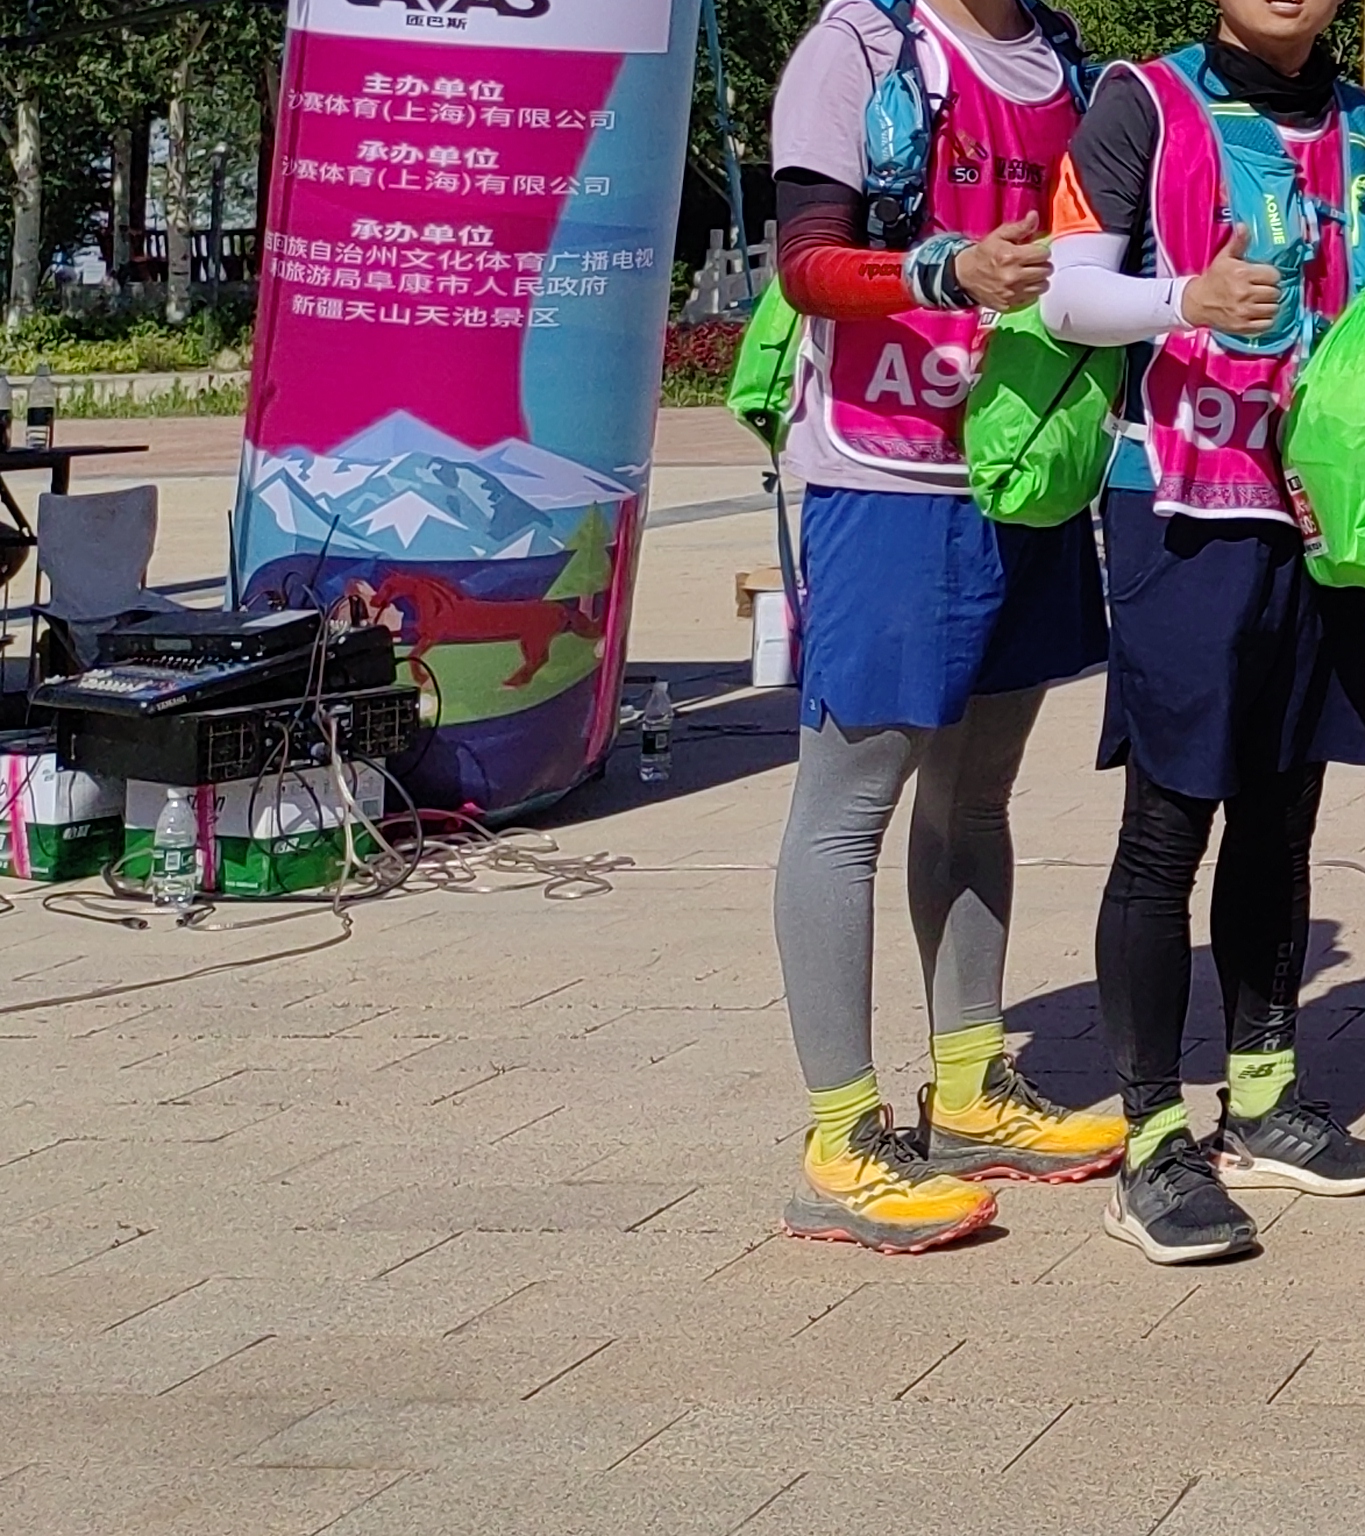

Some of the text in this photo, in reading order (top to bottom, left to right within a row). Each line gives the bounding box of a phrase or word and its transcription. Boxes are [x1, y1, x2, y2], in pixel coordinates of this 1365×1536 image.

[362, 72, 505, 103] 主办单位
[356, 140, 500, 170] 承办单位
[351, 218, 495, 248] 承办单位
[1263, 193, 1287, 246] AONIJIE
[292, 294, 562, 330] 新疆天山天池景区
[864, 342, 982, 411] A9
